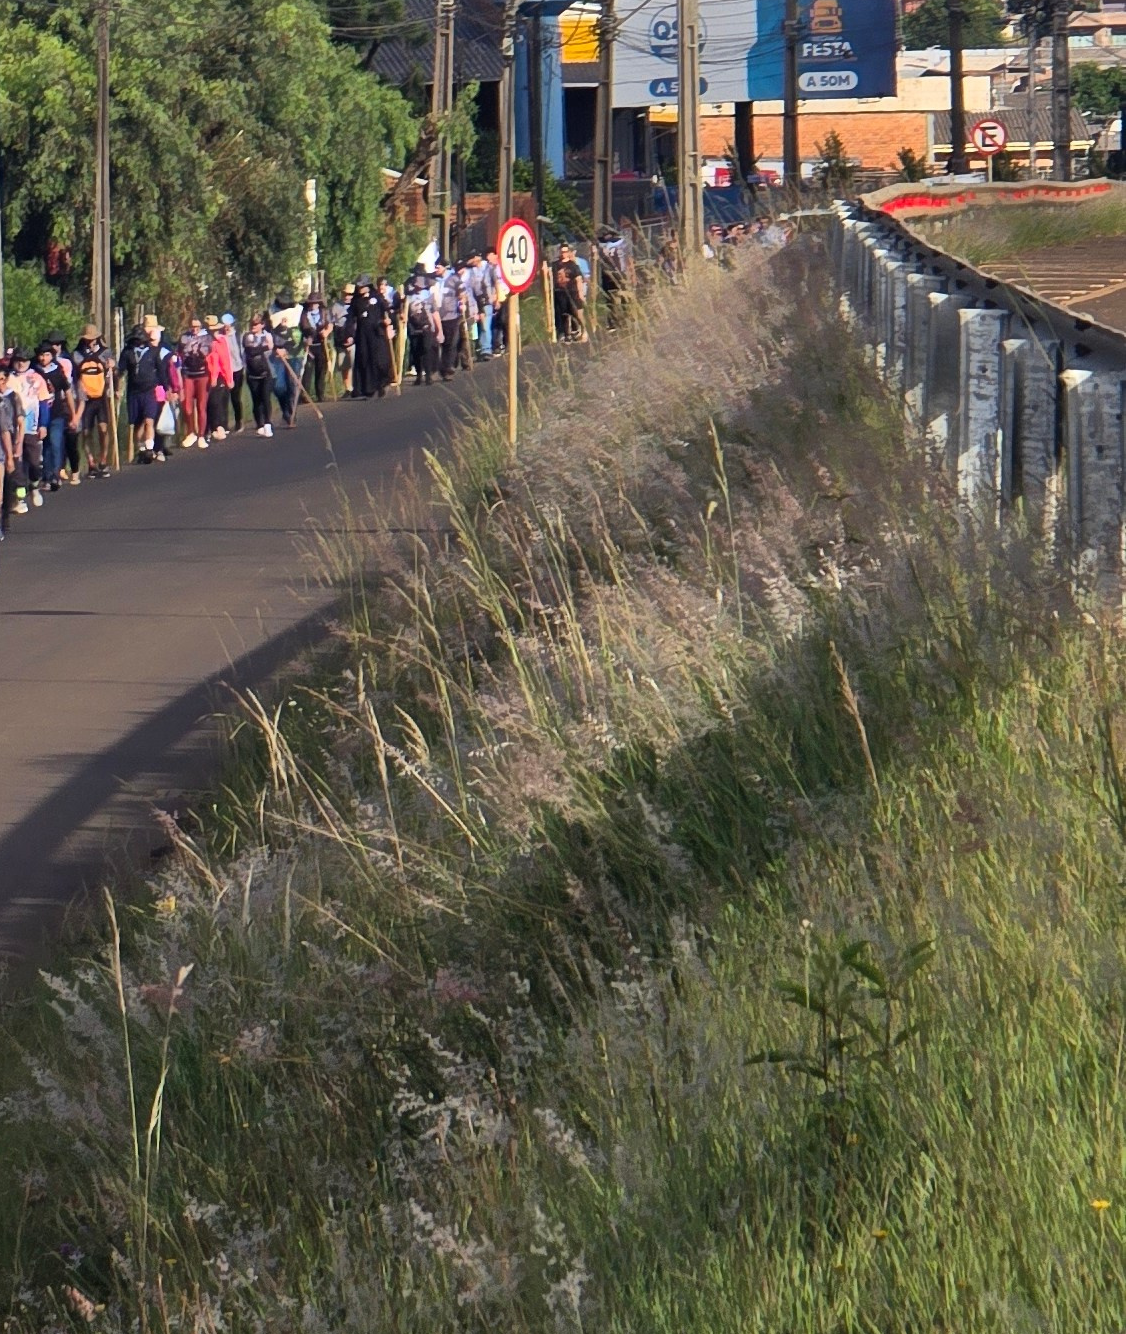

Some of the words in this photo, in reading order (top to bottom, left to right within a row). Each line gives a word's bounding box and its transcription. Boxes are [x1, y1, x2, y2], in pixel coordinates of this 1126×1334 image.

[802, 41, 853, 57] FESTA
[806, 75, 817, 87] A
[820, 74, 851, 87] 50M
[506, 234, 528, 264] 40
